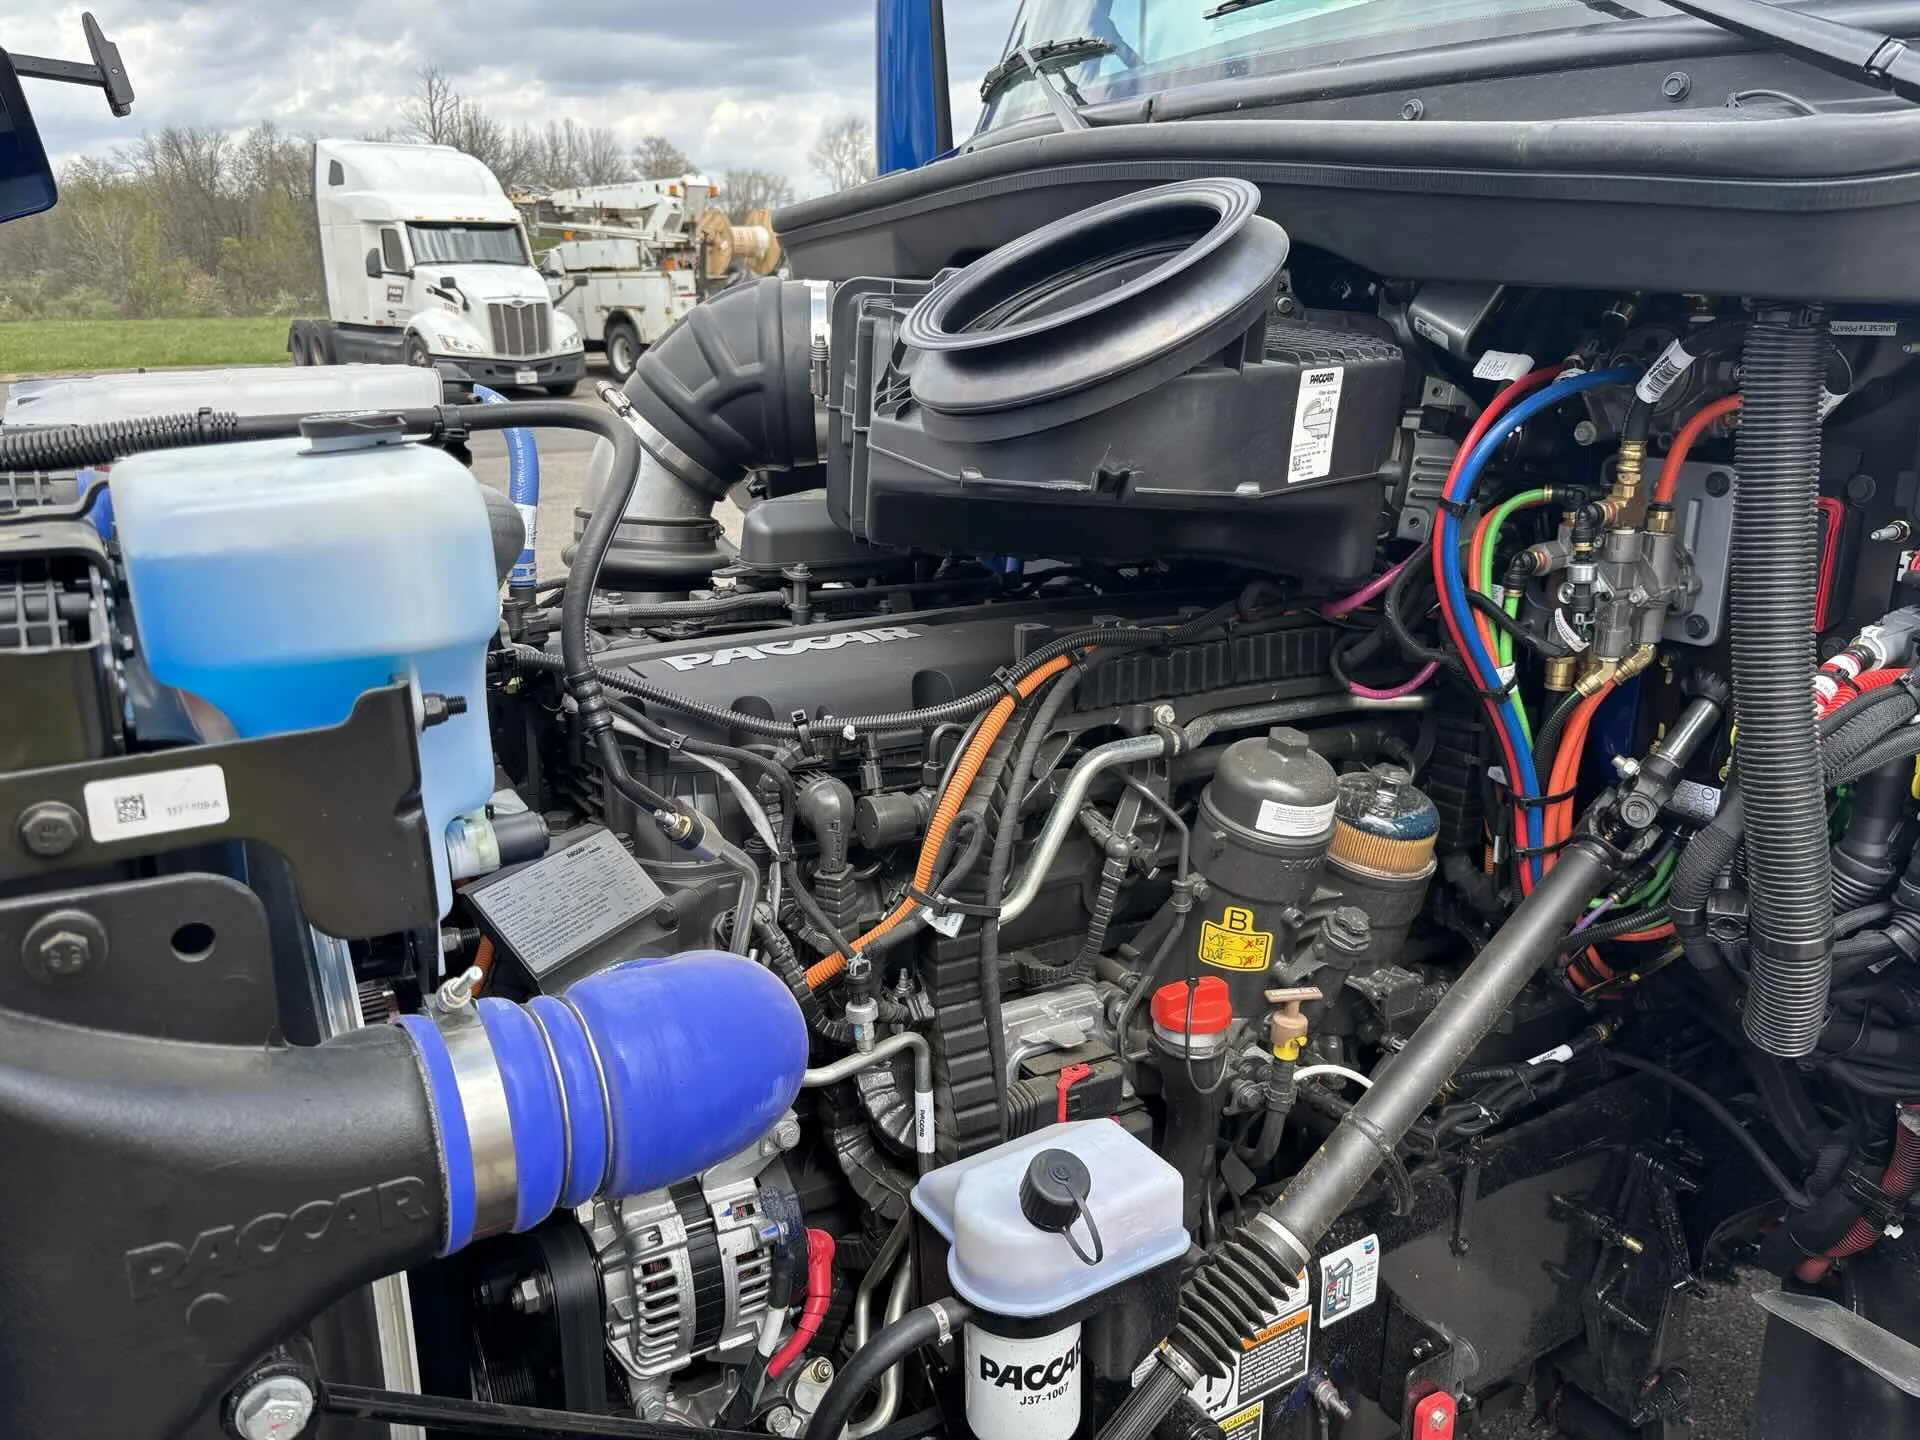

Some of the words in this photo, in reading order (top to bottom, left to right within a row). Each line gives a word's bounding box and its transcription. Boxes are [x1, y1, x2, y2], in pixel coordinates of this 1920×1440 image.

[1309, 372, 1335, 385] PACCAR
[660, 626, 925, 672] PACCAR
[1229, 910, 1247, 931] B
[126, 1176, 430, 1301] PACCAR
[1260, 1318, 1297, 1342] WARNING
[1019, 1382, 1070, 1406] J37-1007
[1226, 1407, 1261, 1431] CAUTION
